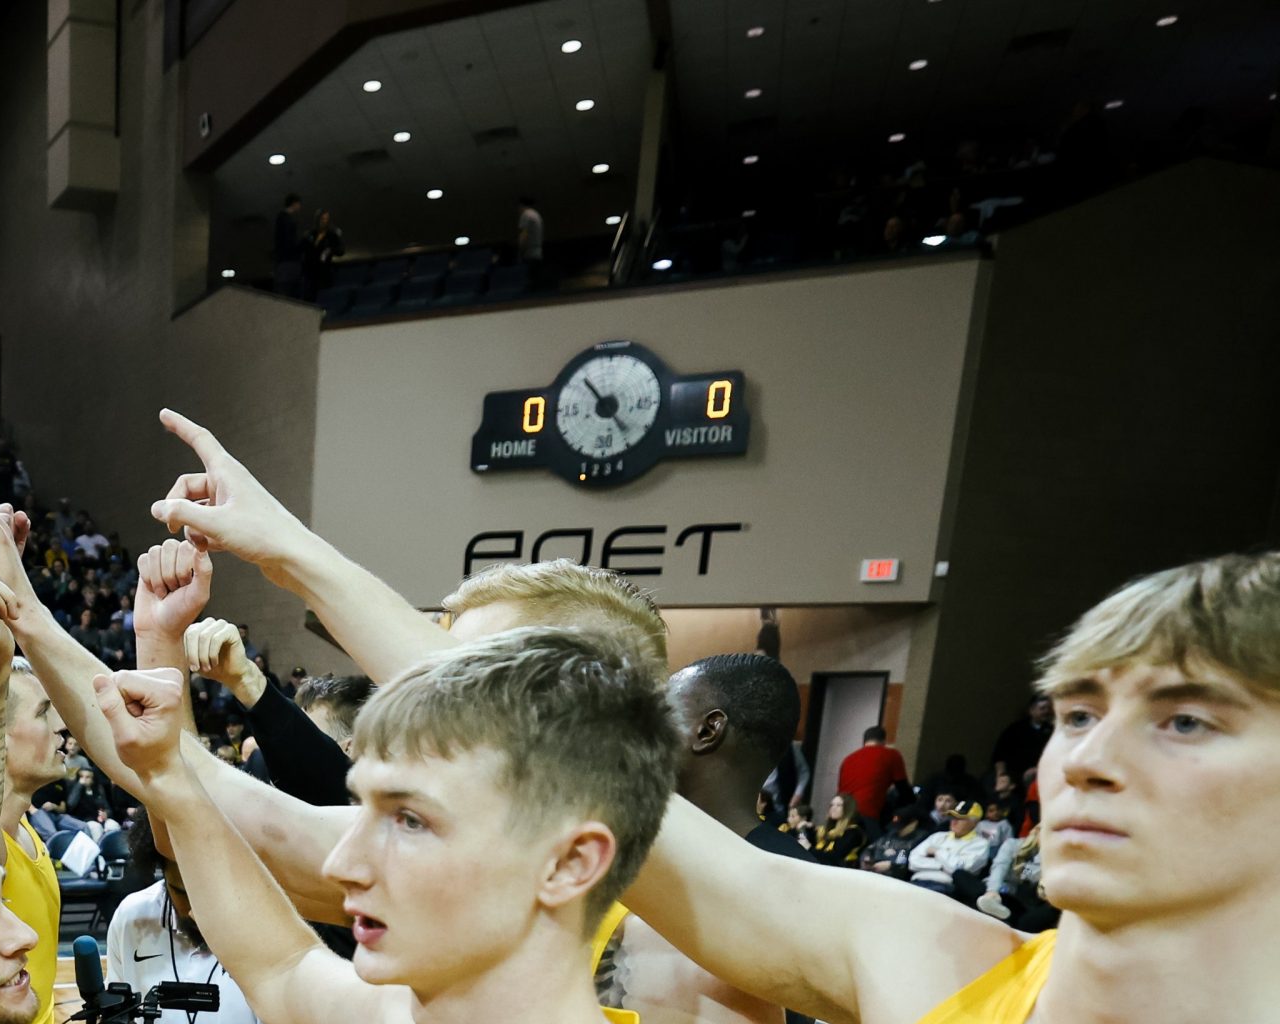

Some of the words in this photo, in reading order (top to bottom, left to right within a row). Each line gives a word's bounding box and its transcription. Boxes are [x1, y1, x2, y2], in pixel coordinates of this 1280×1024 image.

[523, 396, 544, 432] 0
[707, 380, 732, 418] 0
[490, 439, 536, 458] HOME
[665, 425, 733, 446] VISITOR
[463, 522, 742, 577] POET
